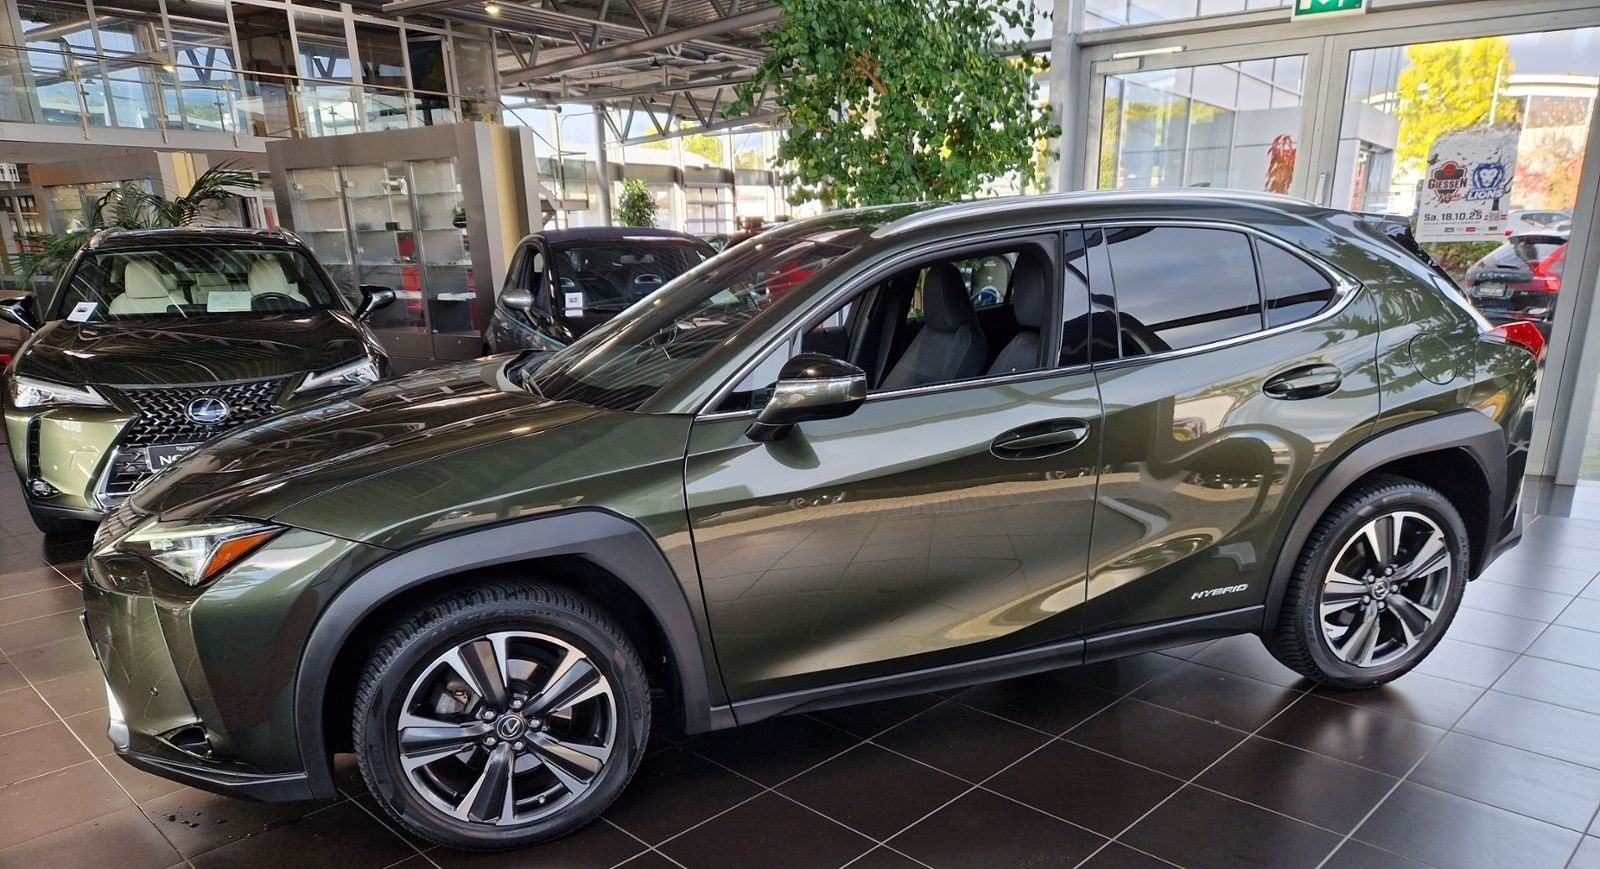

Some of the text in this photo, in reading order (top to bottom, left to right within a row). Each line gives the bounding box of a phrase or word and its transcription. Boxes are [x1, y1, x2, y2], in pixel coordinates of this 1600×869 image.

[1428, 178, 1468, 189] GIESSEN
[1466, 189, 1504, 201] LIONS
[1441, 211, 1482, 221] 18.10.25
[1190, 583, 1249, 600] HYBRID
